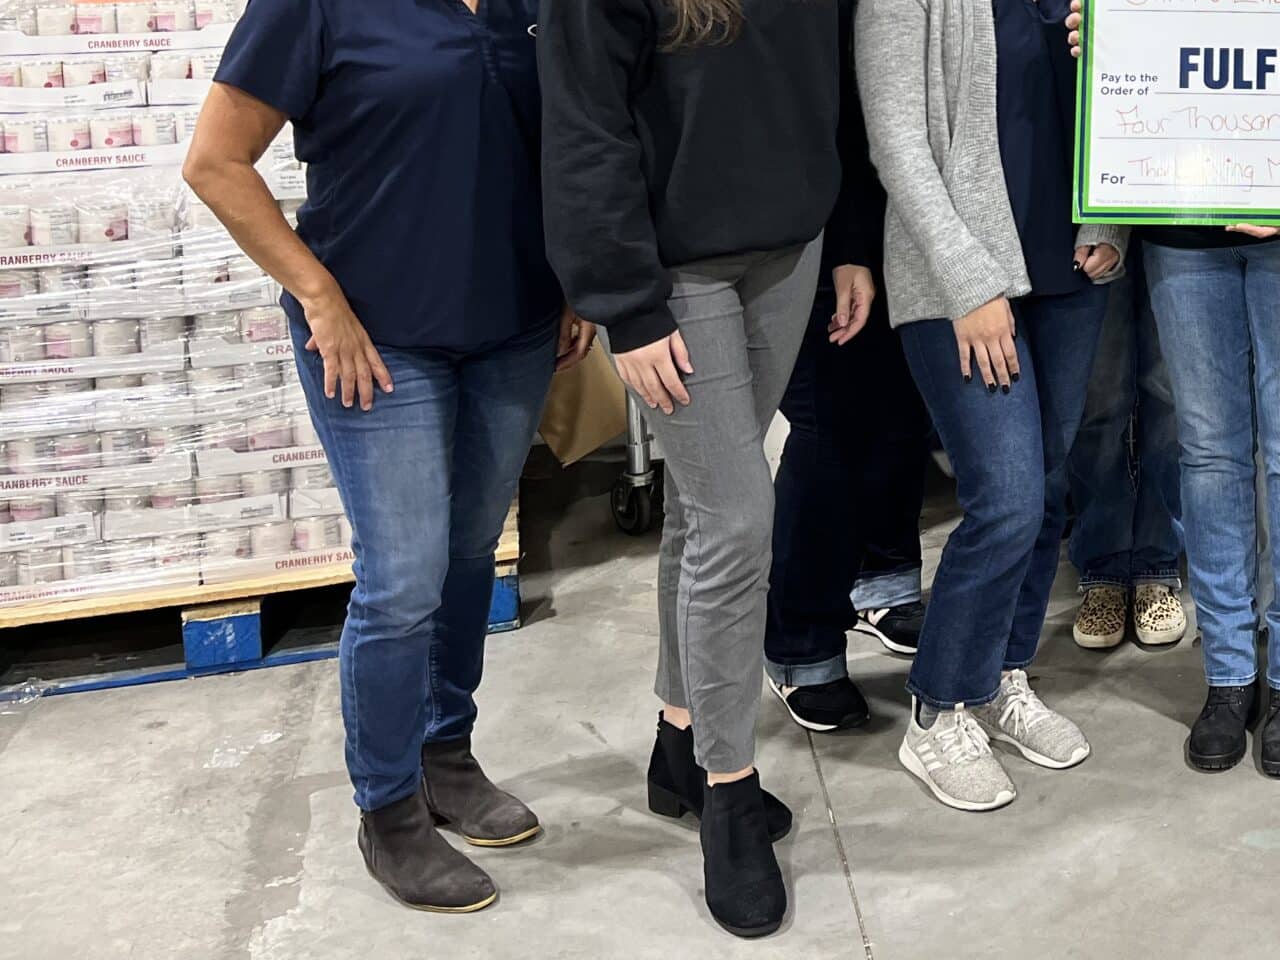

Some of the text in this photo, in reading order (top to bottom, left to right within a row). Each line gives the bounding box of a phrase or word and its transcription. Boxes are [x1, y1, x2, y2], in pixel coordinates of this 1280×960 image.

[88, 38, 172, 49] CRANBERRY SAUCE
[1101, 73, 1159, 83] Pay to the
[1101, 86, 1149, 96] Order of
[1116, 104, 1169, 134] Four
[56, 154, 147, 168] CRANBERRY SAUCE
[1100, 173, 1126, 185] For
[0, 253, 56, 266] RANBERRY
[272, 450, 324, 463] CRANBERR
[0, 474, 88, 490] RANBERR SAUCE
[275, 551, 355, 570] CRANBERRY SAU
